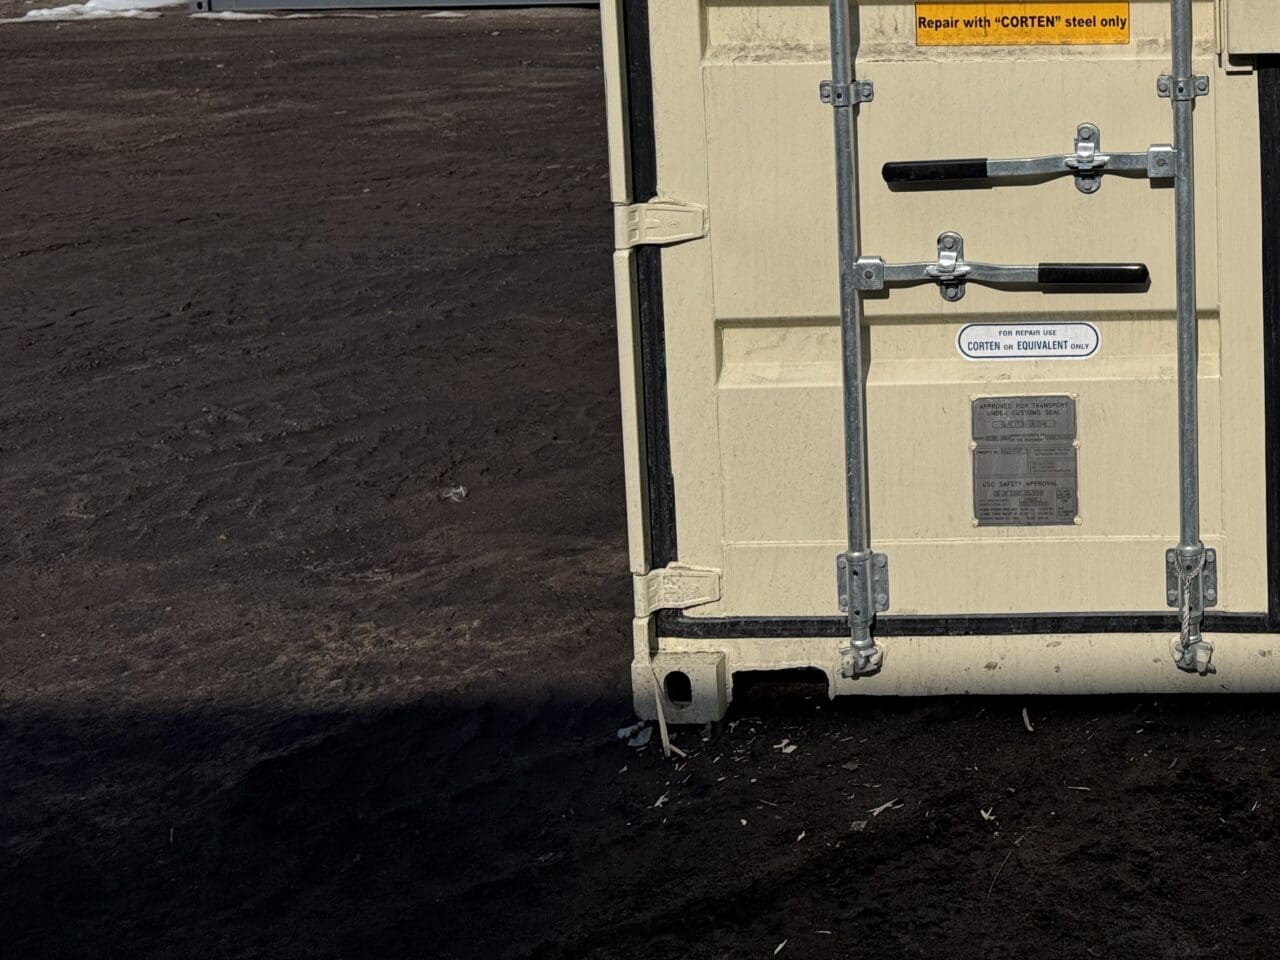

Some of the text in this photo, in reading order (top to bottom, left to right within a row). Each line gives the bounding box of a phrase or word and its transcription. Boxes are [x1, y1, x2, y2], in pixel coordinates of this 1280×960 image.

[918, 16, 1127, 31] Repair with “CORTEN” steel only
[967, 341, 1000, 351] CORTEN
[1017, 340, 1068, 350] EQUIVALENT
